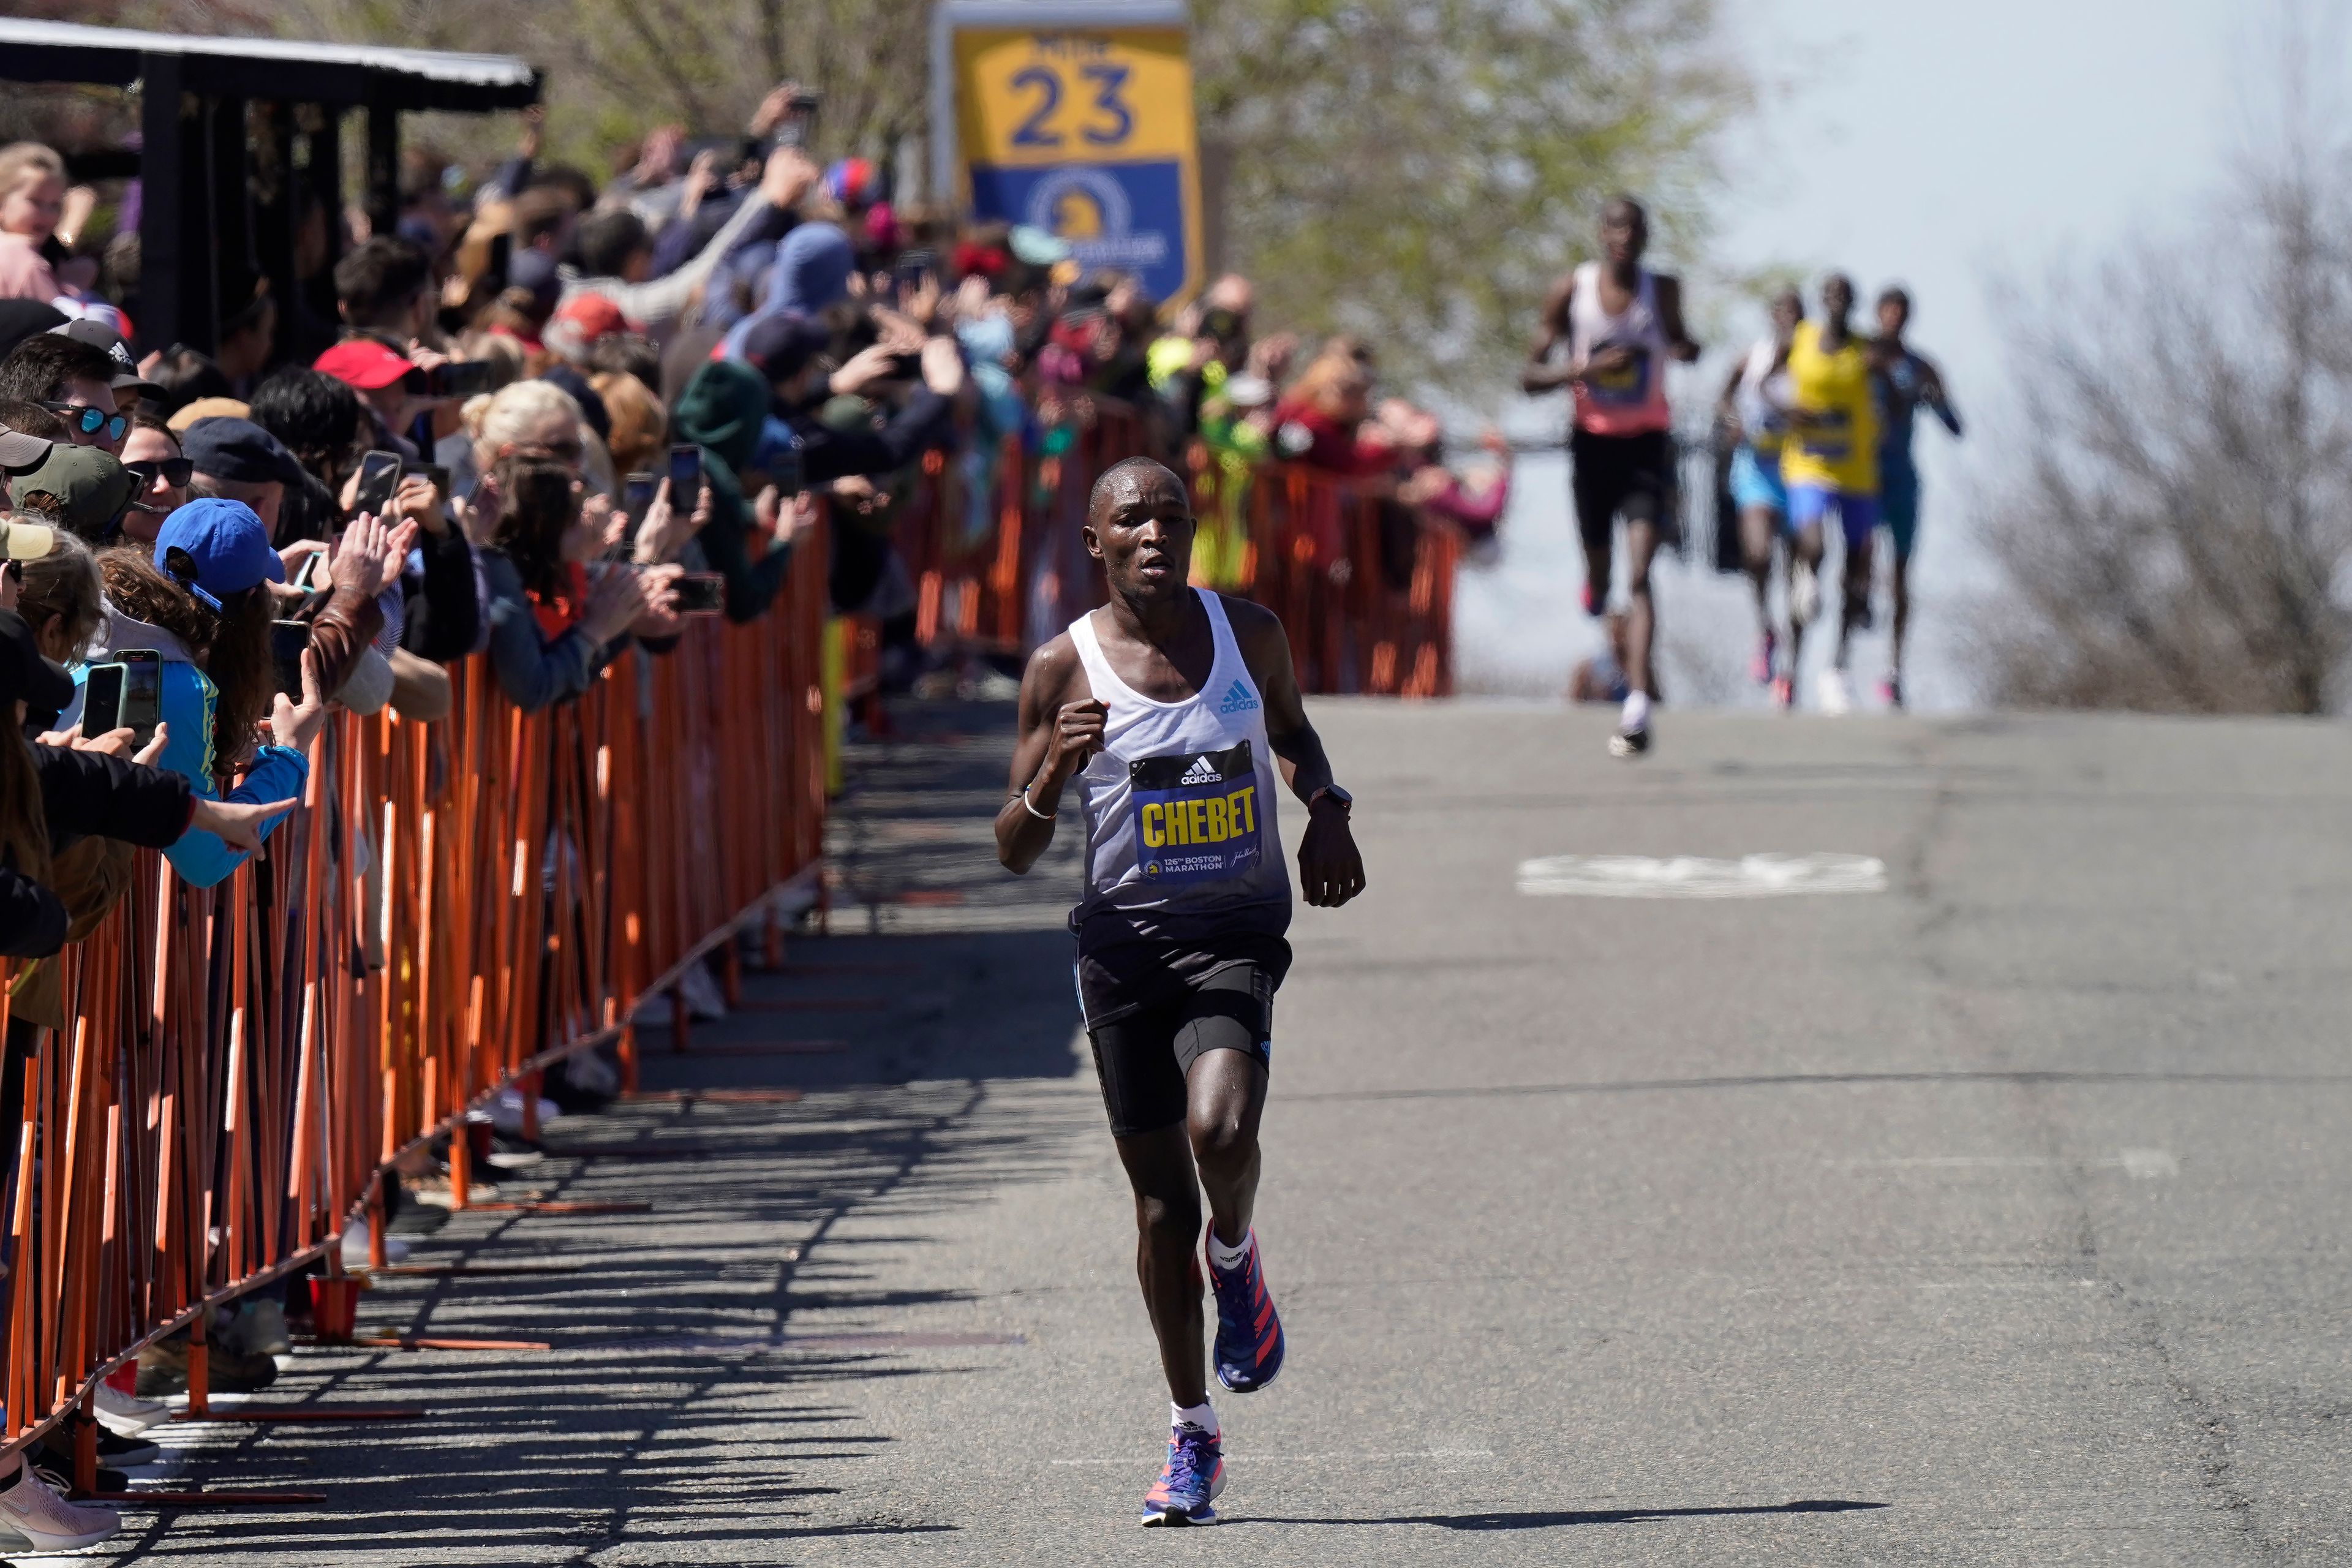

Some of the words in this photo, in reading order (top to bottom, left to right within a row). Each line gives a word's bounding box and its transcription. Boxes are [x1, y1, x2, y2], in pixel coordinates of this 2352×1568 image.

[1009, 65, 1133, 147] 23
[1219, 699, 1259, 714] adidas
[1181, 773, 1223, 785] adidas
[1141, 786, 1254, 848] CHEBET
[1185, 855, 1221, 864] BOSTON
[1166, 862, 1223, 873] MARATHON
